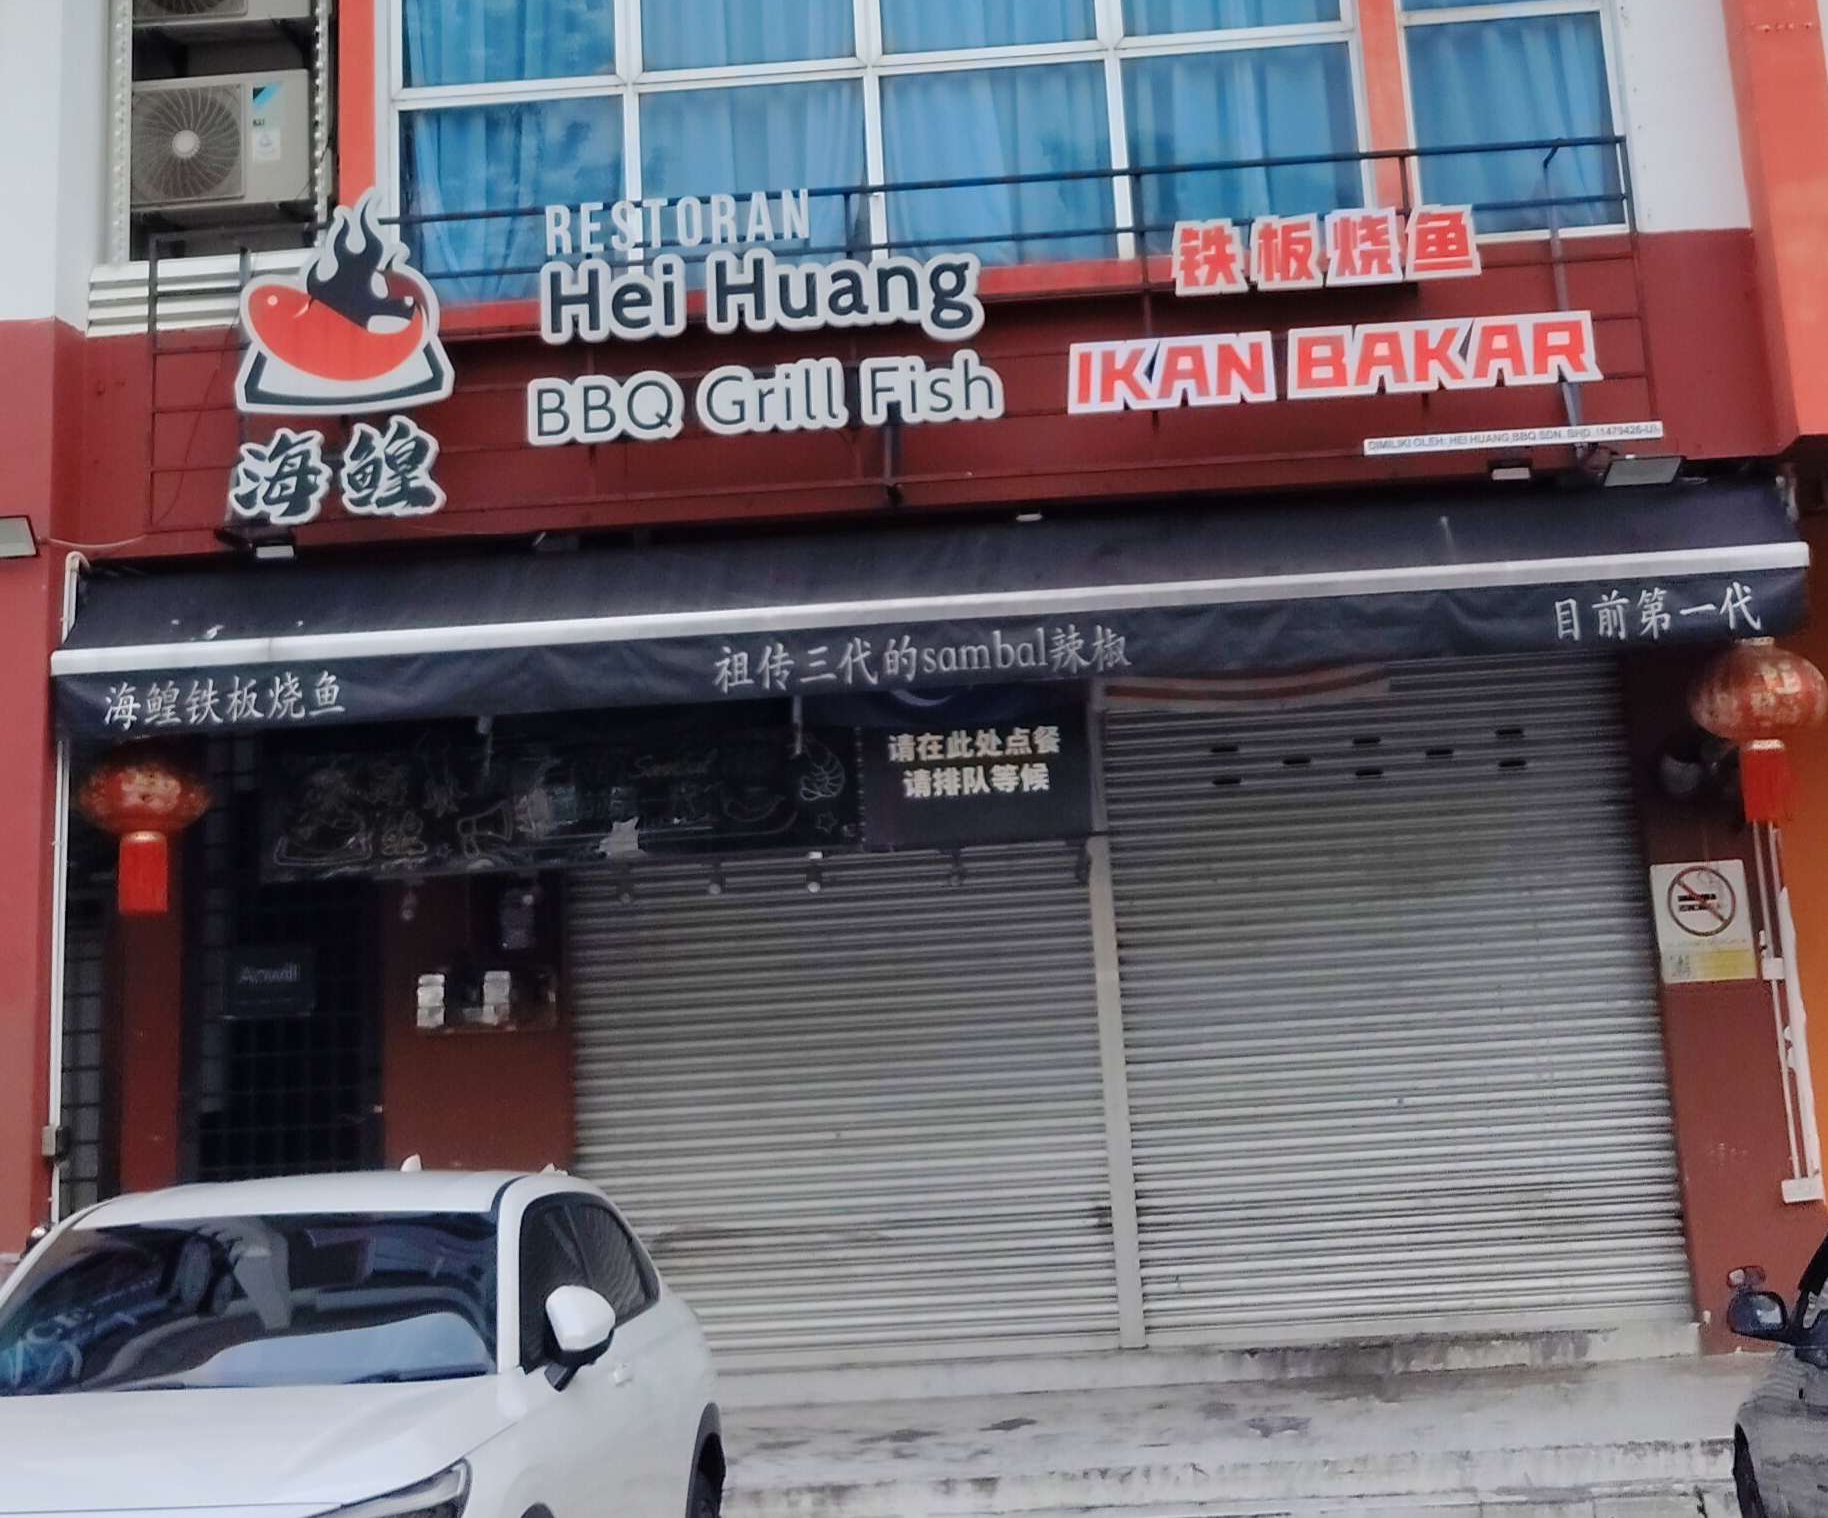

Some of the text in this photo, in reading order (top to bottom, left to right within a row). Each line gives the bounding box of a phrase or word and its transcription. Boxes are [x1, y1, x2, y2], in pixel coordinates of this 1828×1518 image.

[545, 188, 811, 257] RESTORAN
[1176, 207, 1478, 292] 铁板烧鱼
[547, 252, 978, 339] Hei Huang
[1075, 318, 1592, 407] IKAN BAKAR
[535, 354, 996, 441] BBQ Grill Fish
[1470, 432, 1509, 445] HUANG
[1511, 431, 1537, 443] BBQ
[1554, 581, 1762, 643] 目前第一代
[888, 725, 1061, 763] 请在此处点餐
[903, 762, 1050, 799] 请排队等候
